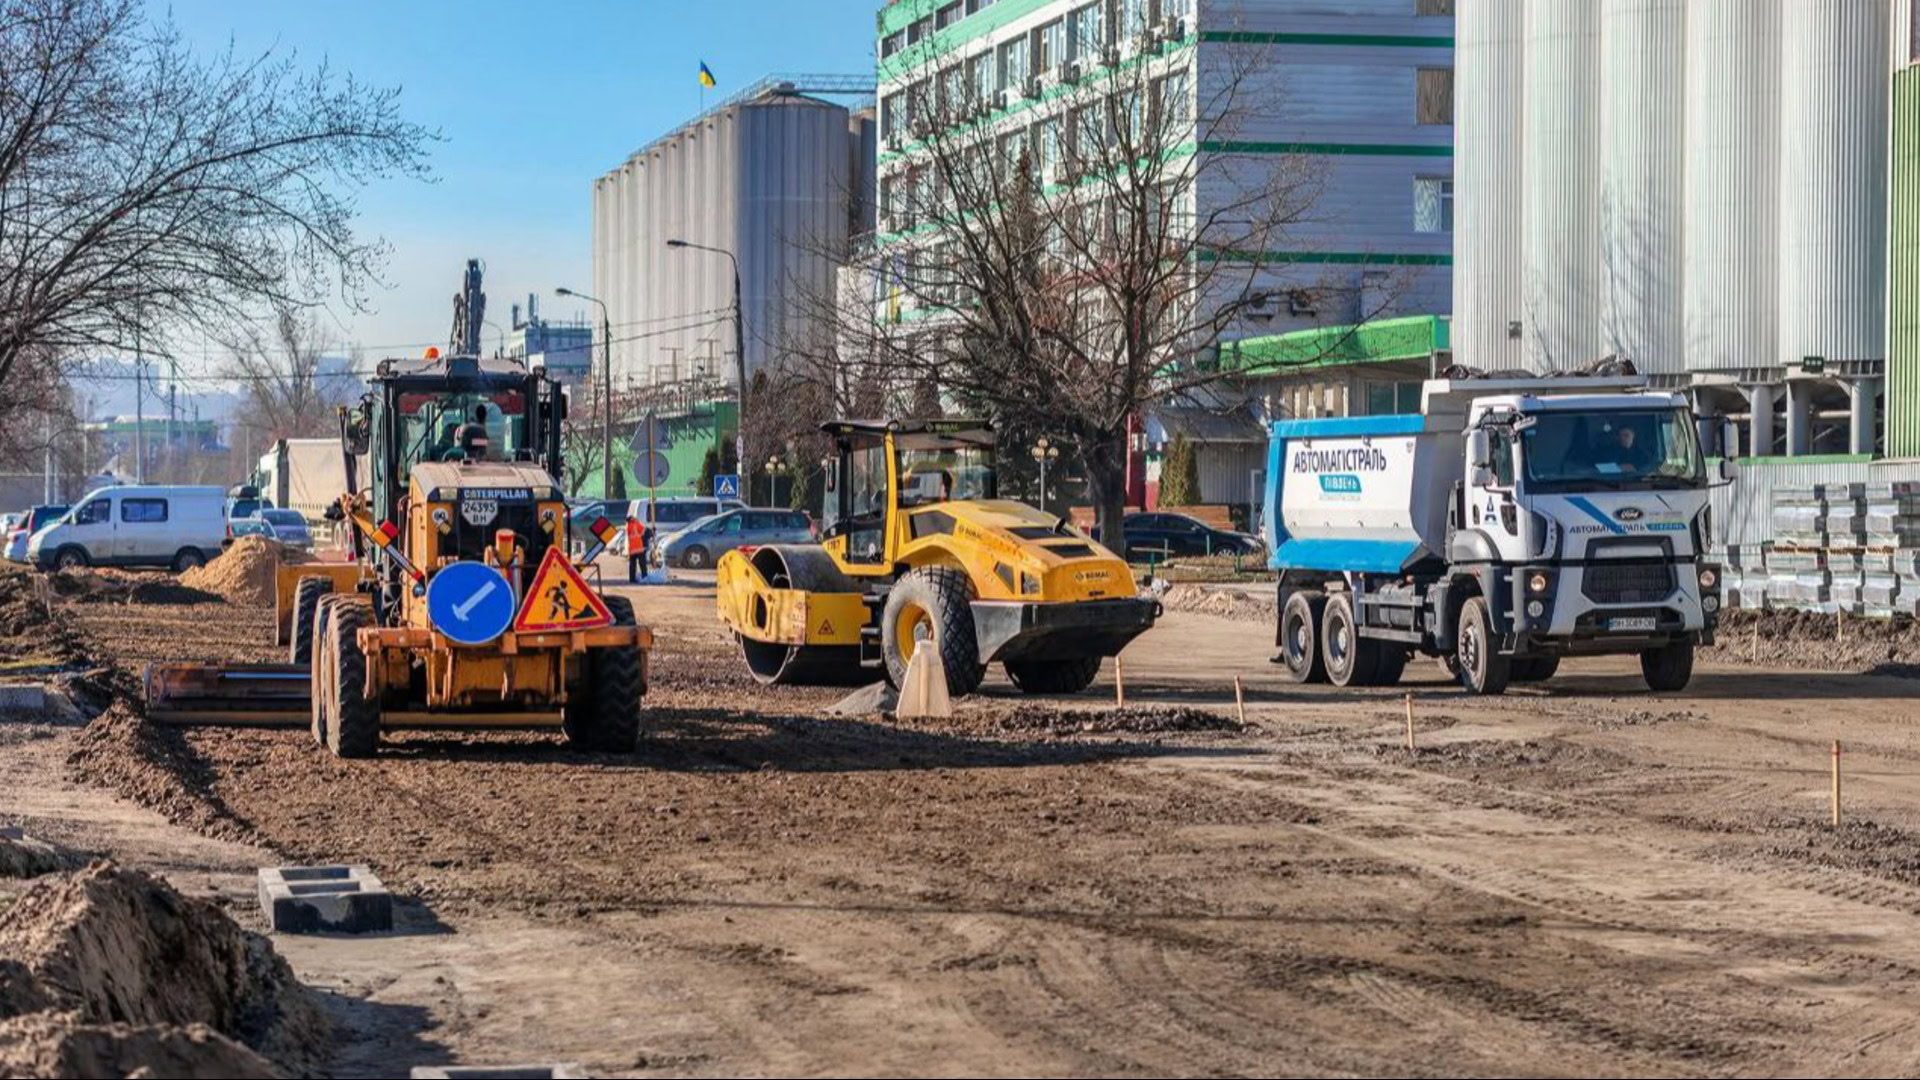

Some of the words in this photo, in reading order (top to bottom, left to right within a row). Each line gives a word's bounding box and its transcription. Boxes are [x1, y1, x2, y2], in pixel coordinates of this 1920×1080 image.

[1293, 448, 1387, 473] АВТОМАГІСТРАЛЬ
[1324, 477, 1358, 490] ПІВДЕНЬ
[463, 488, 528, 499] CATERPILLAR
[464, 502, 496, 514] 24395
[1569, 523, 1646, 535] АВТОМАГТРАЛЬ
